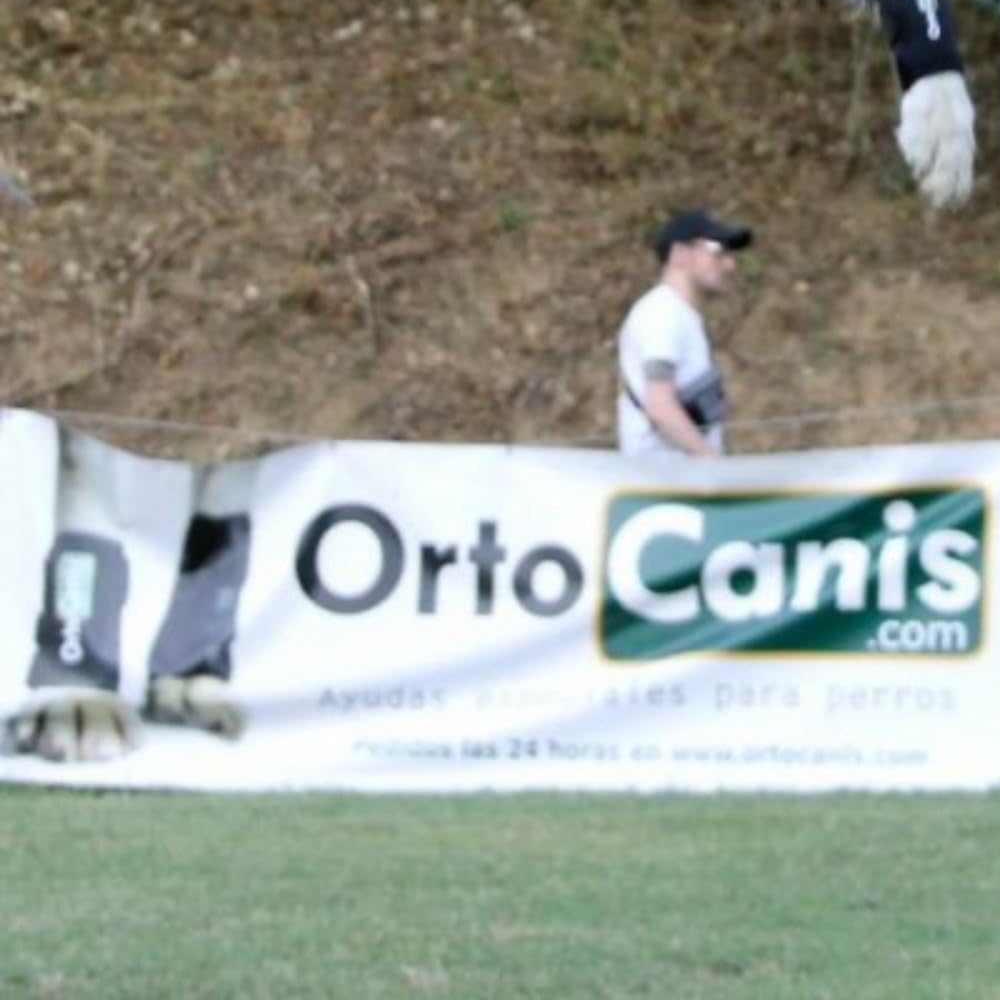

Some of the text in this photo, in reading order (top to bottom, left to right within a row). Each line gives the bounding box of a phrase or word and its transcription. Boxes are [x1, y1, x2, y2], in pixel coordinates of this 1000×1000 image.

[866, 617, 969, 652] .com
[317, 687, 447, 712] Ayudas
[714, 682, 800, 712] para
[826, 683, 957, 717] perros
[507, 737, 538, 759] 24
